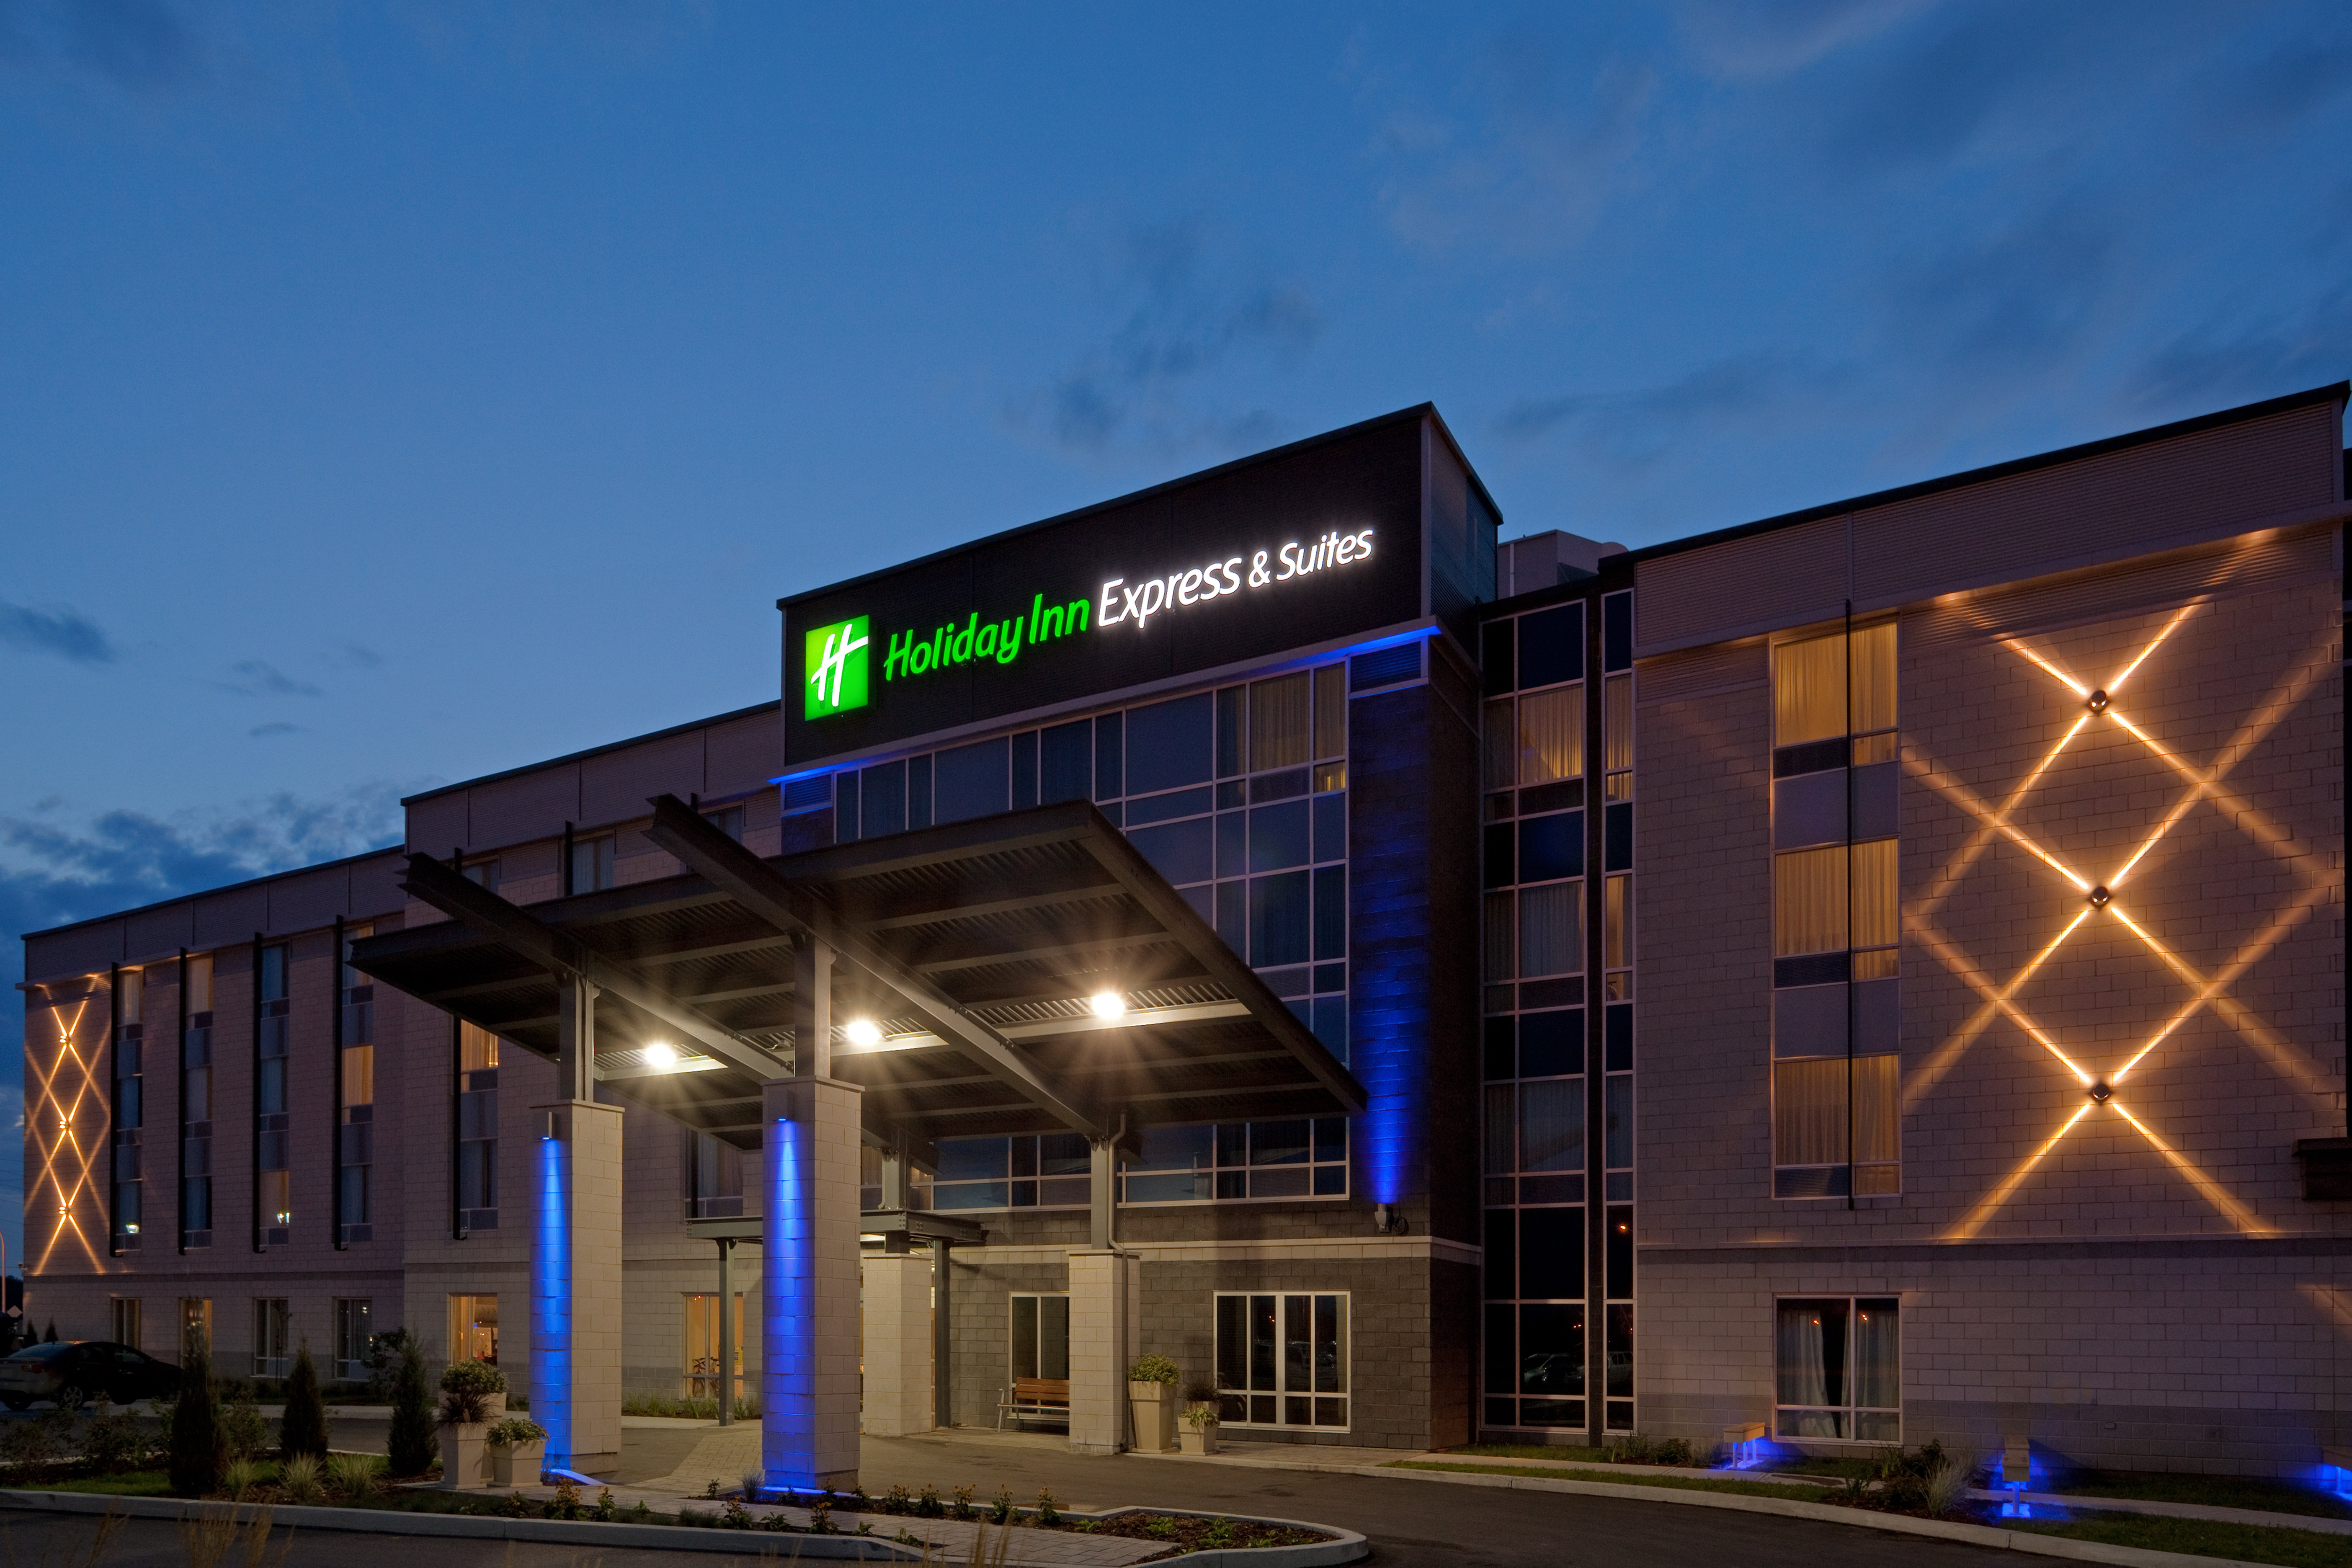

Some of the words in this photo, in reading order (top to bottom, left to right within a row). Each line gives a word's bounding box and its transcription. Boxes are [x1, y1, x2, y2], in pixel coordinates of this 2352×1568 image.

[883, 611, 1024, 681] Holiday
[1029, 593, 1091, 645] Inn
[1097, 557, 1243, 629] Express
[1248, 550, 1271, 588] &
[1276, 529, 1373, 581] Suites
[810, 623, 869, 707] H
